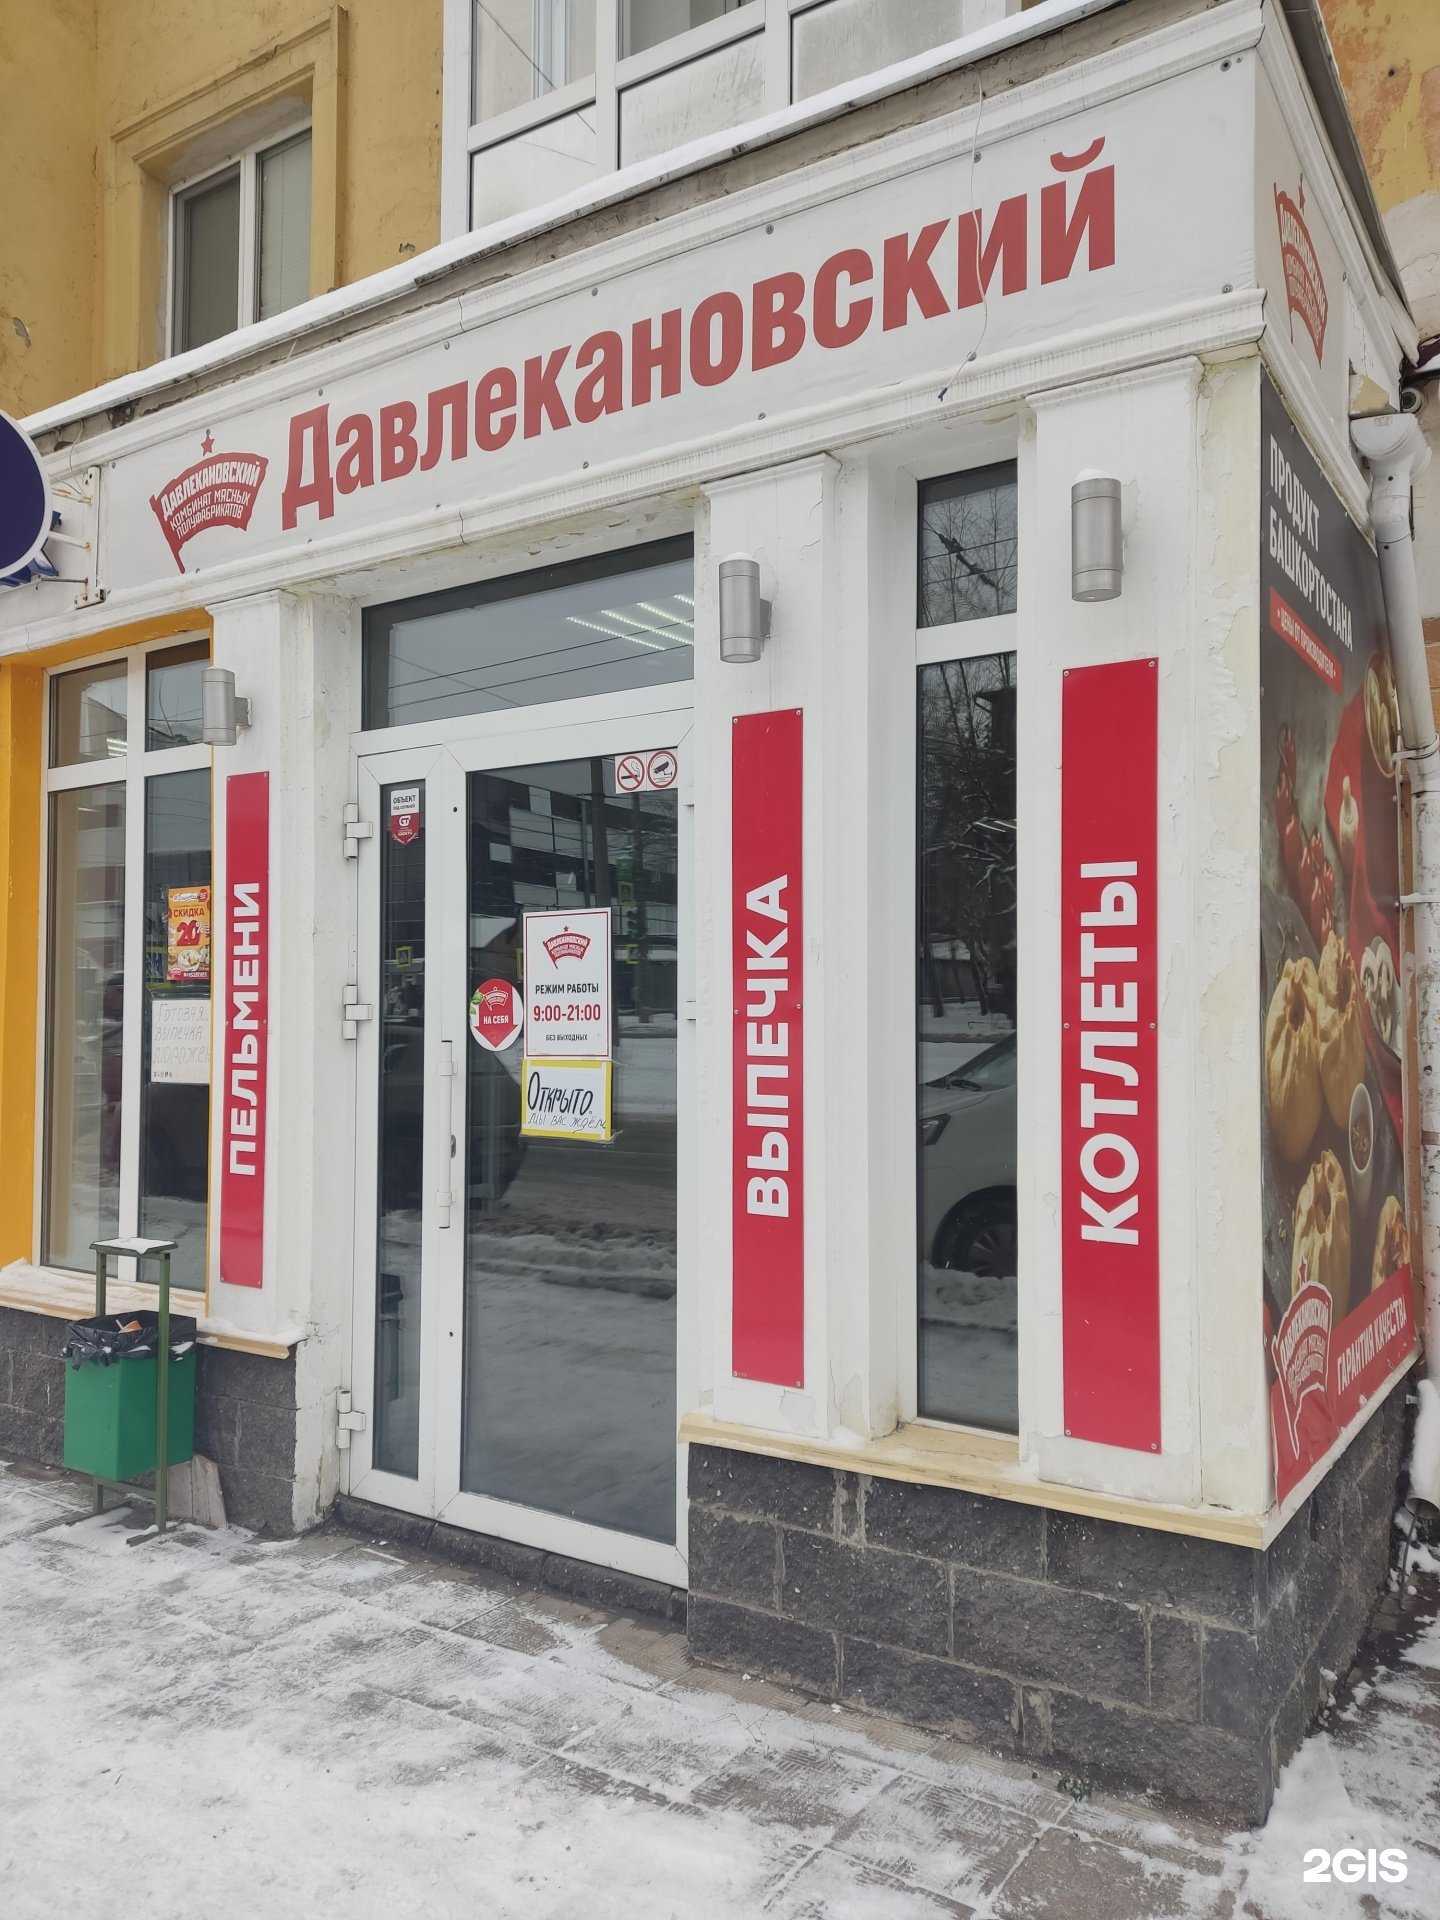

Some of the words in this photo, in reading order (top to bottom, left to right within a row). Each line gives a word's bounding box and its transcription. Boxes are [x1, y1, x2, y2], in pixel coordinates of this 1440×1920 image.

[281, 136, 1116, 531] Давлекановский
[159, 460, 261, 521] ДАВЛЕКАНОВСКИЙ
[170, 490, 212, 531] КОМБИНАТ
[214, 488, 251, 507] МЯСНЫХ
[176, 502, 244, 540] ПОЛУФАБРИКАТОВ
[1270, 432, 1320, 552] ПРОДУКТ
[1269, 504, 1353, 652] БАШКОРТОСТАНА
[173, 907, 205, 919] СКИДКА
[533, 1003, 602, 1022] 9:00-21:00
[535, 983, 565, 995] РЕЖИМ
[566, 982, 600, 994] РАБОТЫ
[229, 882, 261, 1177] ПЕЛЬМЕНИ
[483, 1015, 492, 1025] НА
[492, 1014, 509, 1025] СЕБЯ
[556, 1033, 588, 1041] ВЫХОДНЫХ
[745, 874, 790, 1219] ВЫПЕЧКА
[1080, 860, 1141, 1246] КОТЛЕТЫ
[1337, 1326, 1375, 1396] ГАРАНТИЯ
